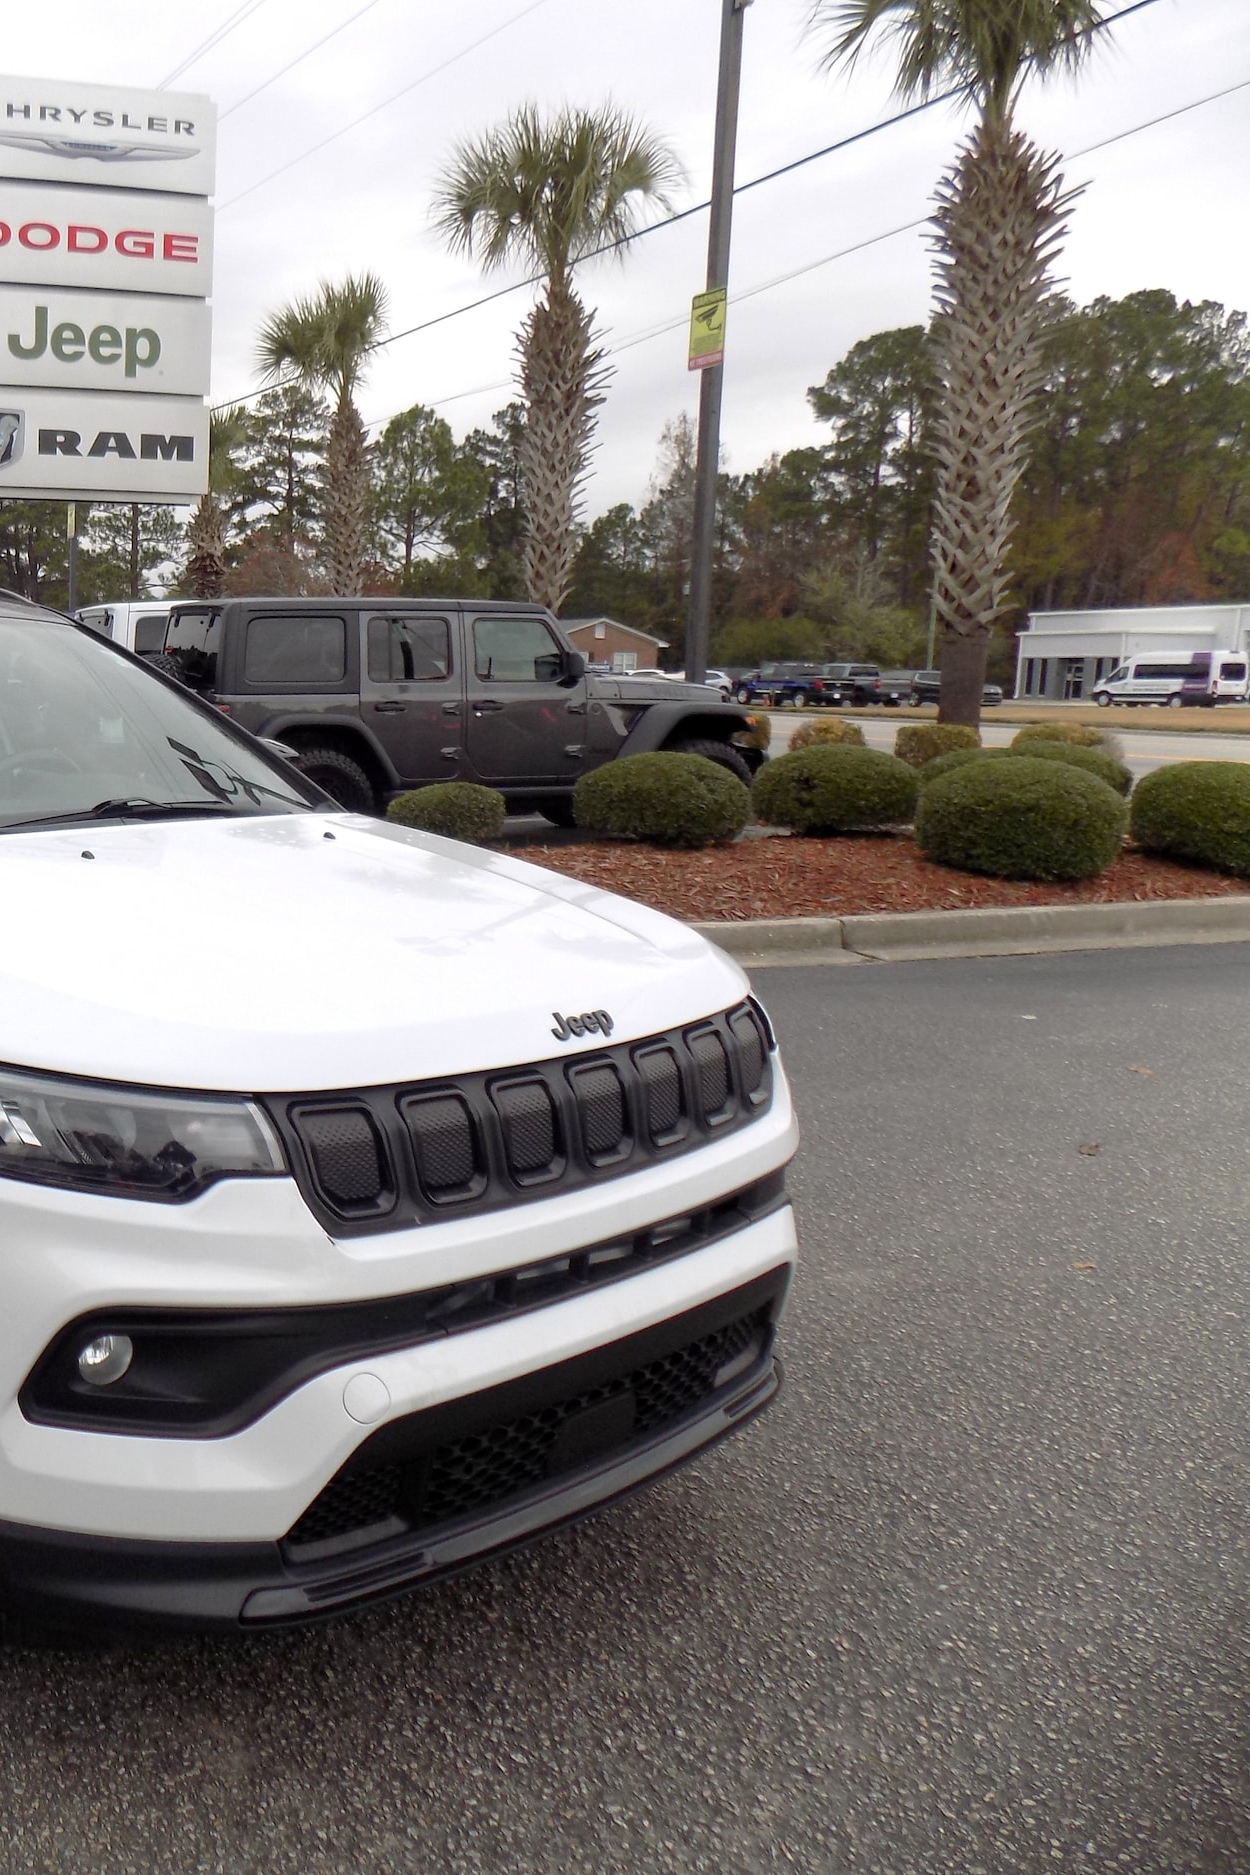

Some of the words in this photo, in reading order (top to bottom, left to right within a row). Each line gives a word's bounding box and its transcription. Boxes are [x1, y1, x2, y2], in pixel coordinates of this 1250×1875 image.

[7, 305, 162, 379] Jeep
[38, 428, 195, 462] RAM
[550, 1009, 615, 1042] Jeep
